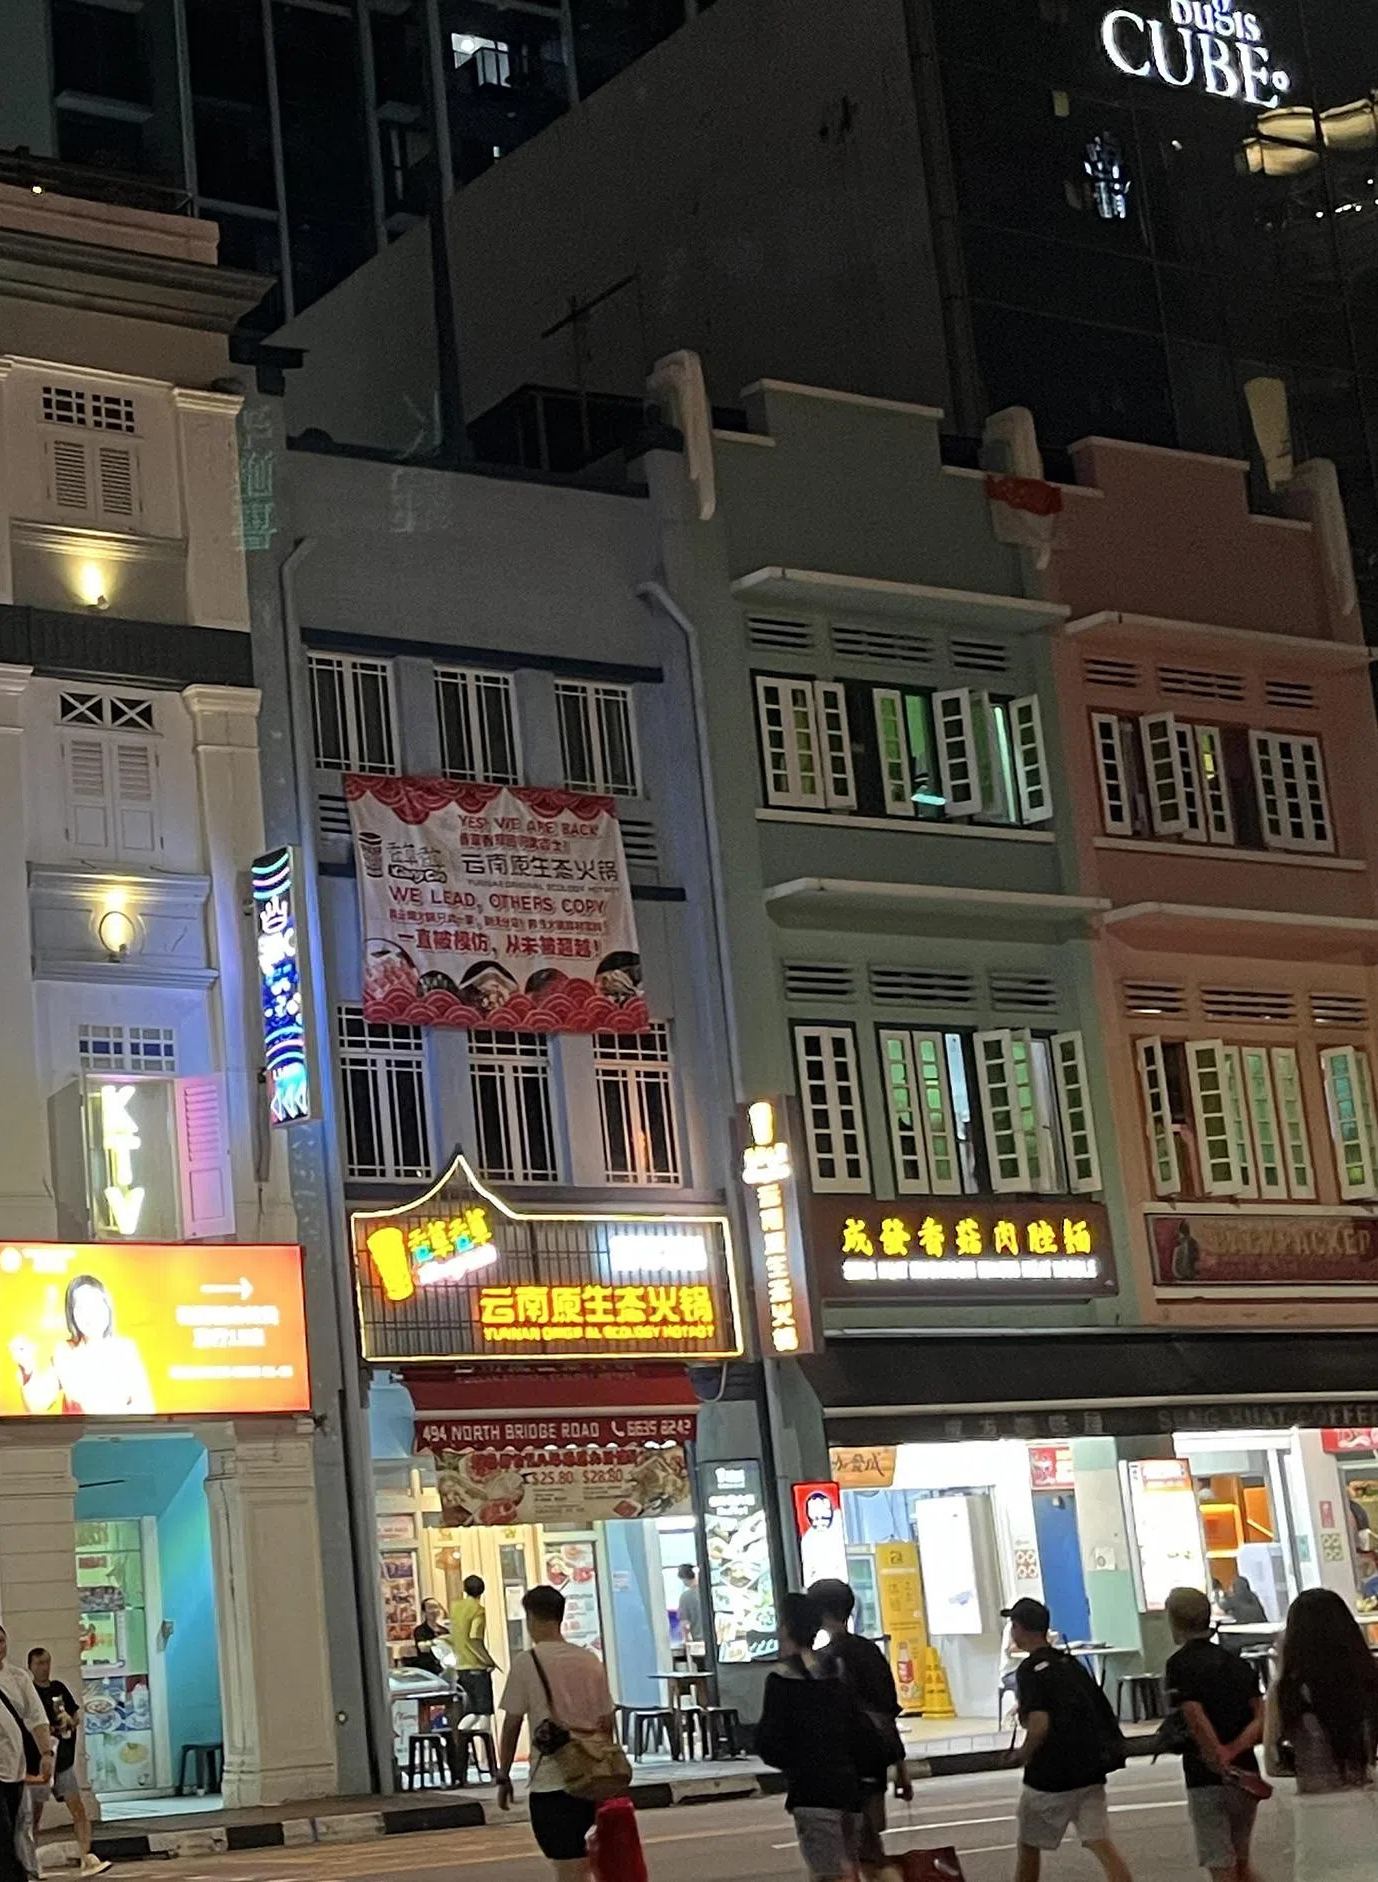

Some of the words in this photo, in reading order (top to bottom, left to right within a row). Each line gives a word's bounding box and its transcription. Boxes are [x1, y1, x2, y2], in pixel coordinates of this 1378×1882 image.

[1102, 10, 1279, 108] CUBE
[494, 816, 520, 830] WE
[527, 820, 556, 834] ARE
[389, 886, 422, 902] WE
[489, 893, 554, 913] OTHERS
[562, 896, 606, 914] COPY
[101, 1085, 145, 1235] KTV
[480, 1284, 714, 1324] 云南原生态火锅
[422, 1424, 448, 1442] 494
[452, 1424, 500, 1441] NORTH
[505, 1423, 557, 1440] BRIDGE
[561, 1422, 600, 1438] ROAD
